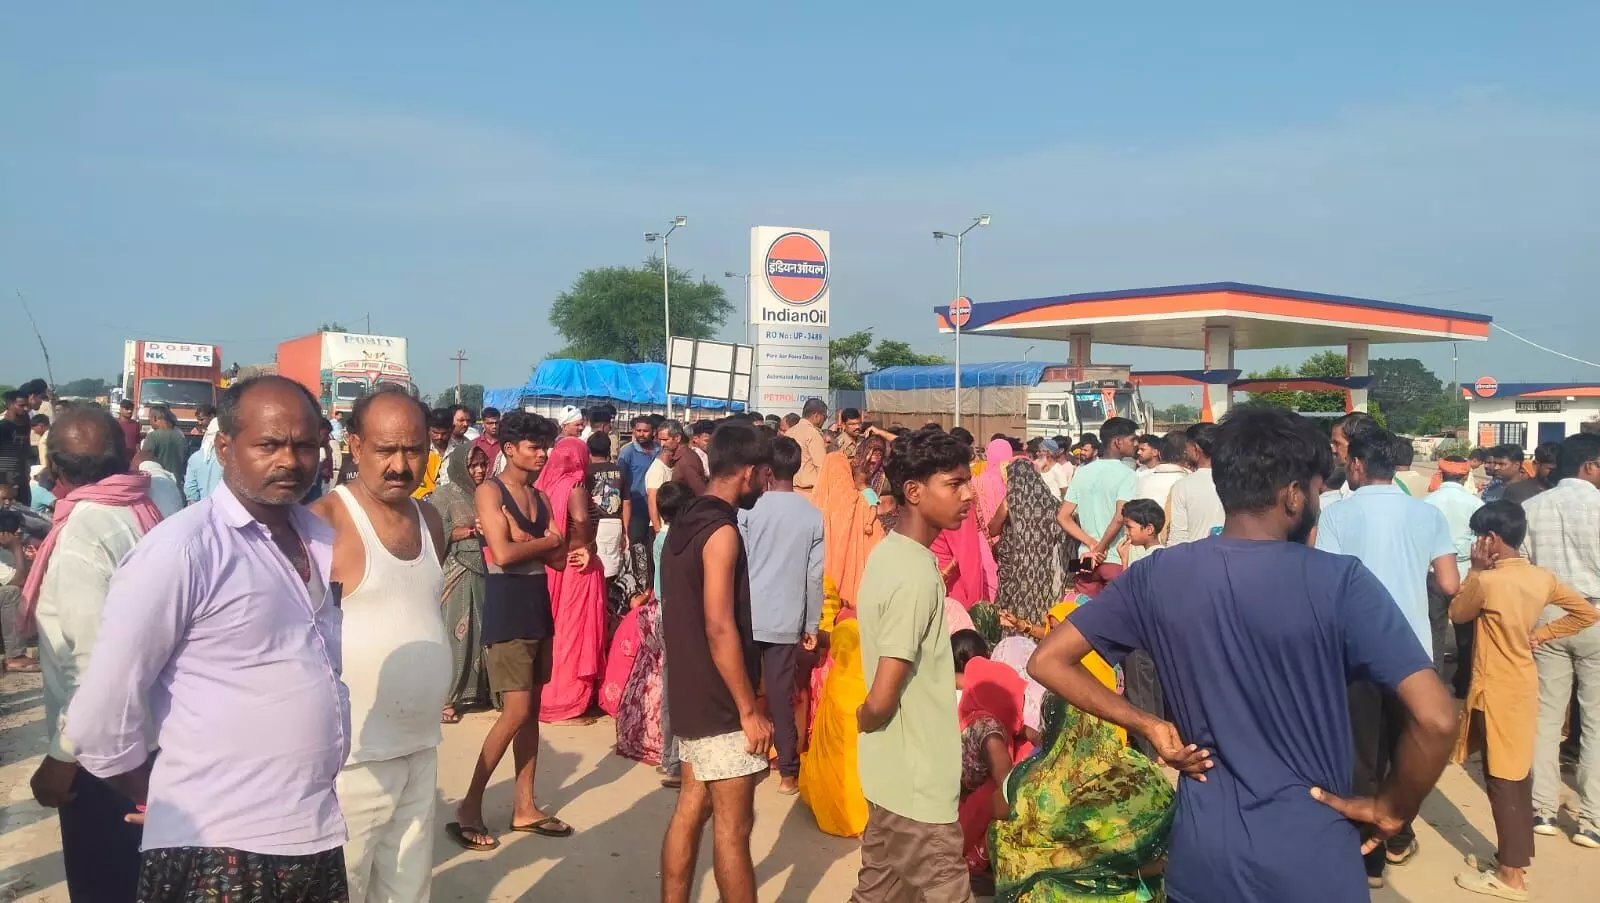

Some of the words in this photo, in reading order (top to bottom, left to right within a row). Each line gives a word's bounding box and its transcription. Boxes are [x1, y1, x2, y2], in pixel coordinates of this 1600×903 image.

[769, 260, 824, 275] इंडियनऑयल
[762, 307, 826, 323] IndianOil
[766, 331, 777, 339] RO
[146, 352, 165, 360] NK
[193, 354, 211, 362] TS
